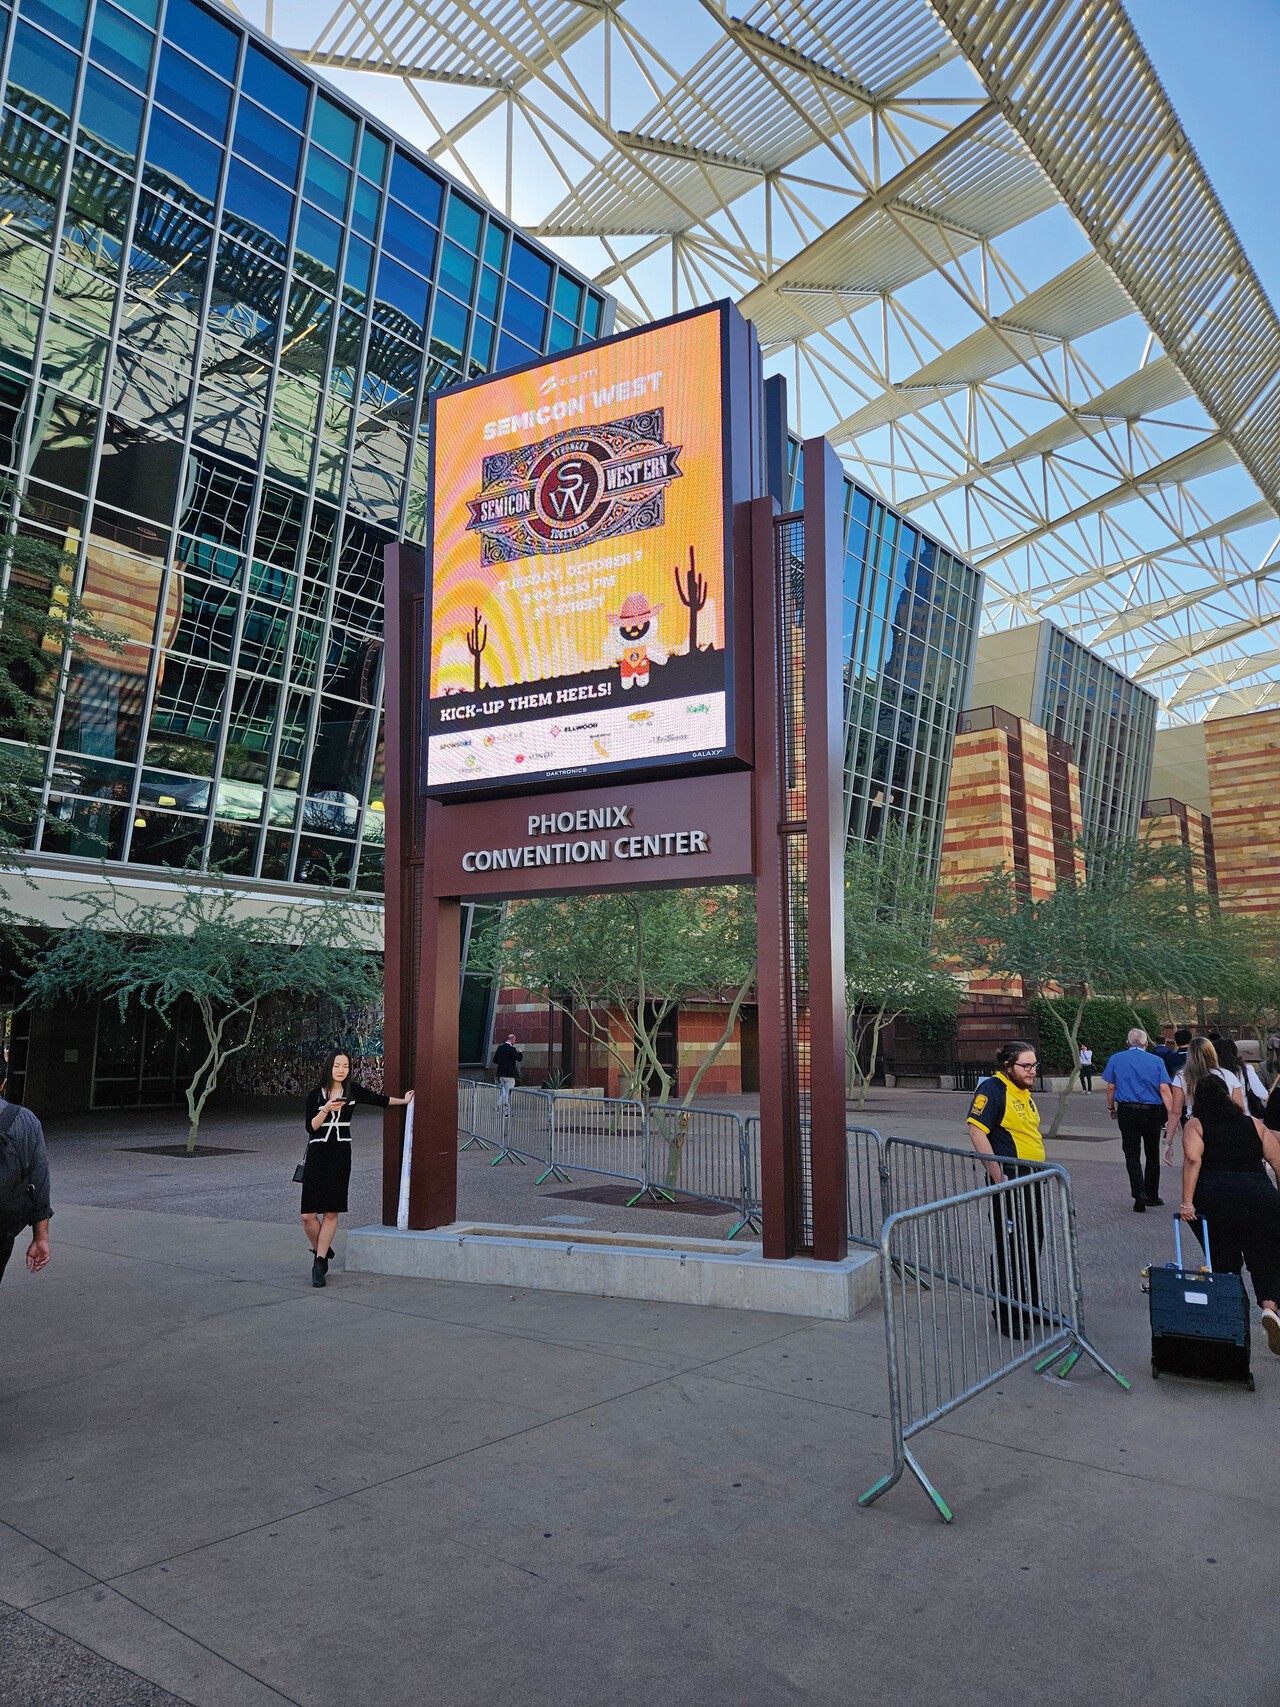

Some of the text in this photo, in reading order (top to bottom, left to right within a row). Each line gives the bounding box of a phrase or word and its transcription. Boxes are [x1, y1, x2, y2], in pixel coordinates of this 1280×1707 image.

[483, 370, 664, 441] SEMICON WEST
[480, 491, 531, 522] SEMICON
[440, 683, 612, 722] KICK-UP THEM HEELS!
[546, 767, 587, 778] DAKTRONICS
[528, 805, 633, 837] PHOENIX
[462, 830, 709, 873] CONVENTION CENTER
